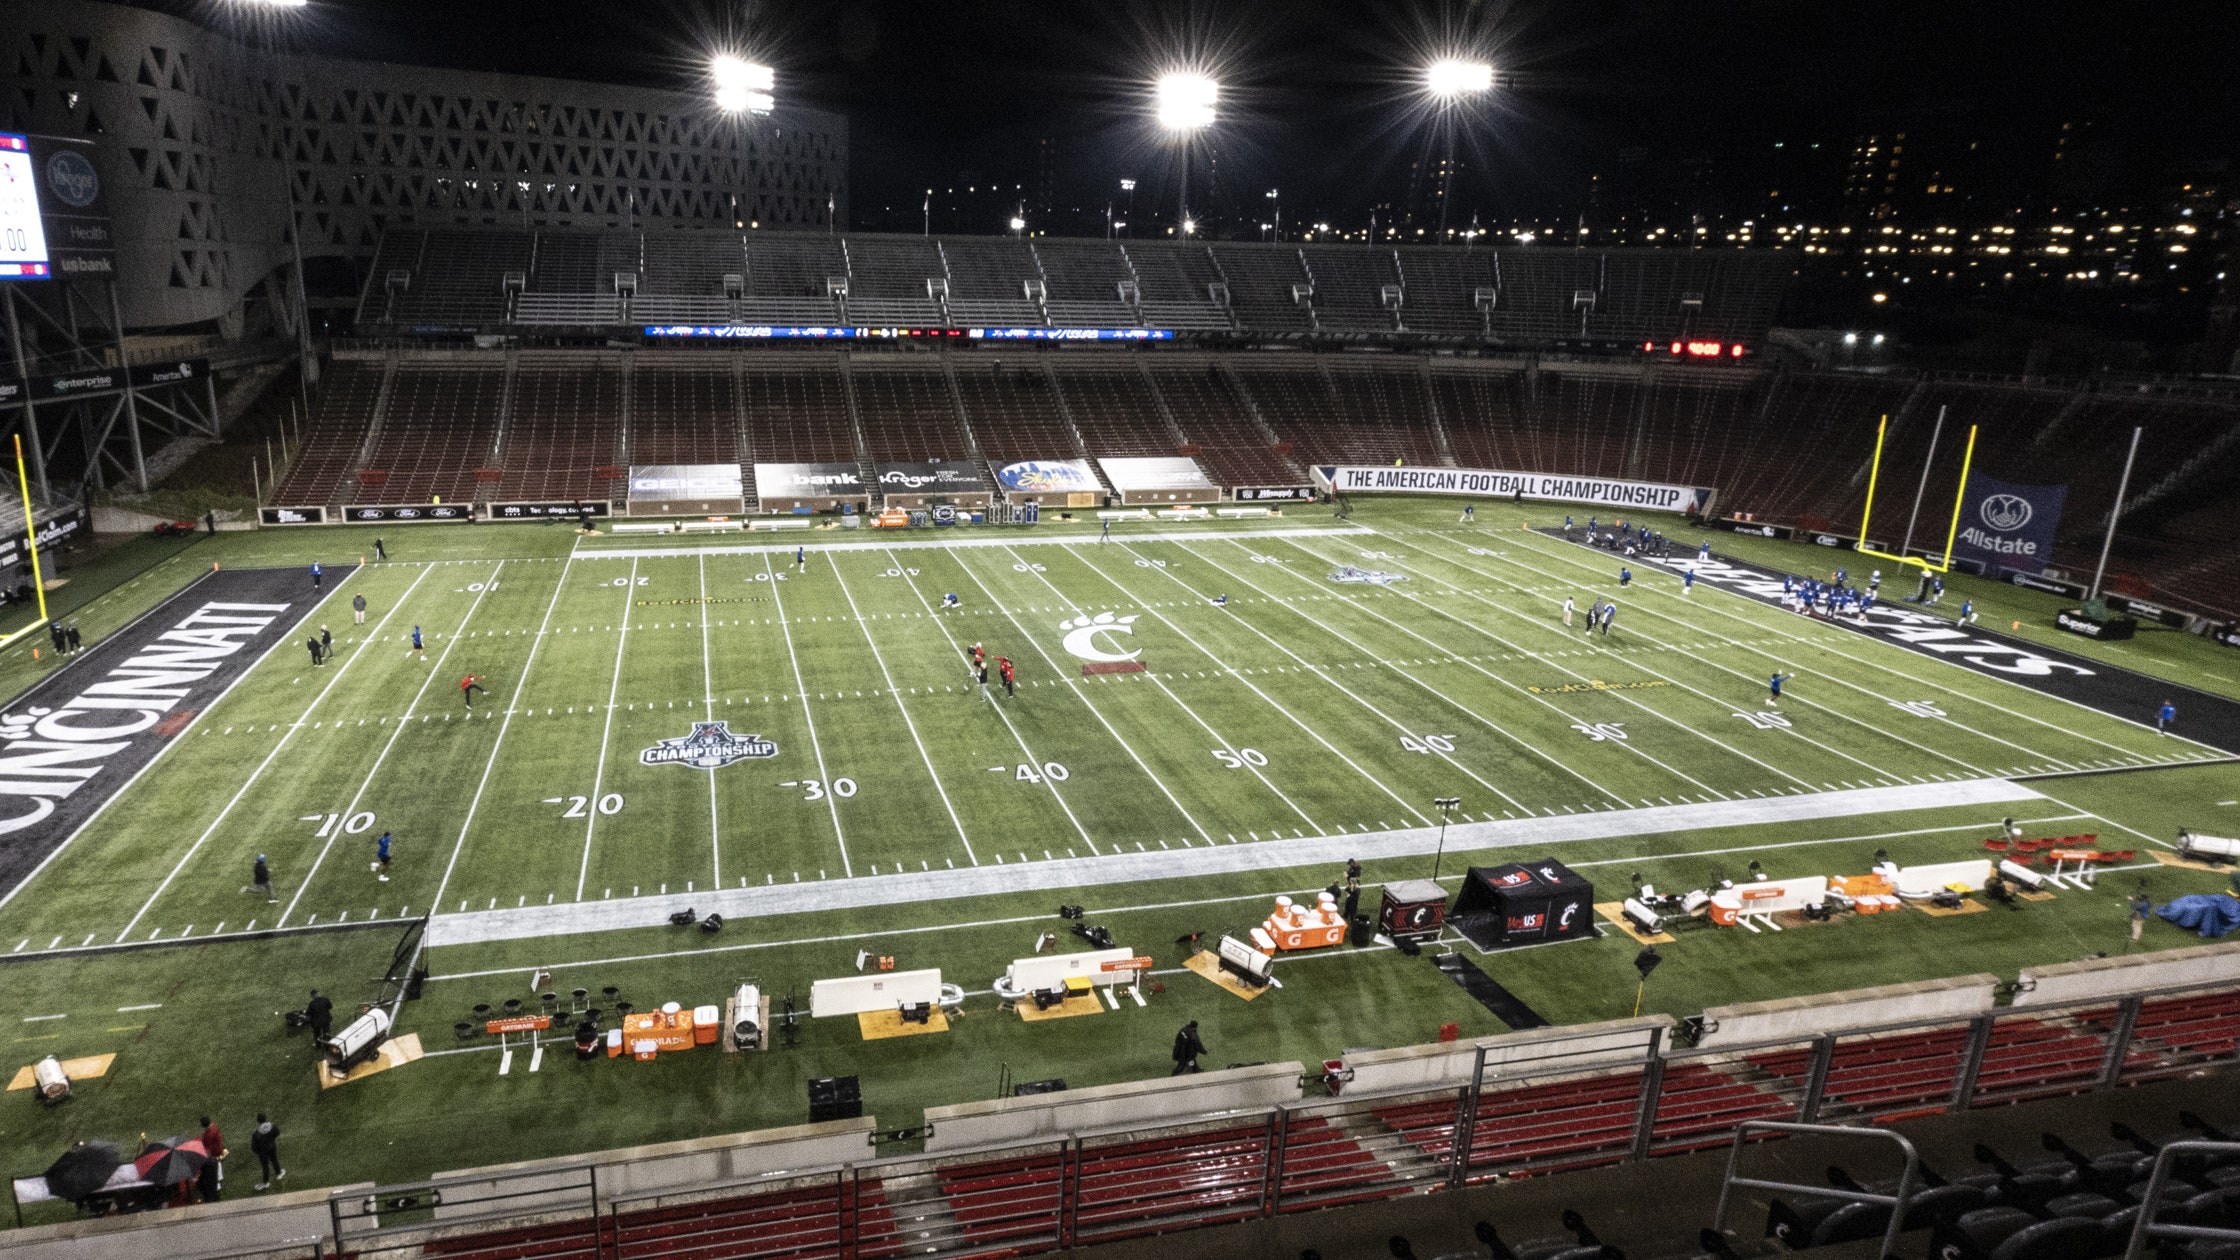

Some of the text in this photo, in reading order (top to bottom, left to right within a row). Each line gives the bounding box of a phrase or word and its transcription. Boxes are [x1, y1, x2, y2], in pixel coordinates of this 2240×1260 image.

[70, 224, 108, 240] Health
[55, 375, 112, 391] enterprise
[153, 371, 182, 382] Ameritas
[793, 473, 860, 485] bank
[879, 471, 937, 488] Kroger
[1258, 489, 1294, 499] Winsupply
[1346, 471, 1680, 507] THE AMERICAN FOOTBALL CHAMPIONSHIP
[504, 506, 520, 514] cbts
[1734, 526, 1763, 536] Ameritas
[1958, 526, 2037, 555] Allstate
[2058, 613, 2101, 636] Superior
[1887, 700, 1948, 718] 10
[1731, 711, 1793, 730] 20
[1570, 723, 1629, 742] 30
[645, 743, 773, 761] CHAMPIONSHIP
[1400, 735, 1456, 755] 40
[1211, 748, 1269, 769] 50
[1015, 762, 1070, 784] 40
[801, 778, 858, 801] 30
[562, 793, 624, 818] 20
[314, 811, 376, 837] 10
[1724, 911, 1736, 922] G
[1288, 934, 1301, 946] G
[1326, 928, 1339, 943] G
[500, 1022, 535, 1031] GATORADE
[641, 1051, 648, 1059] G
